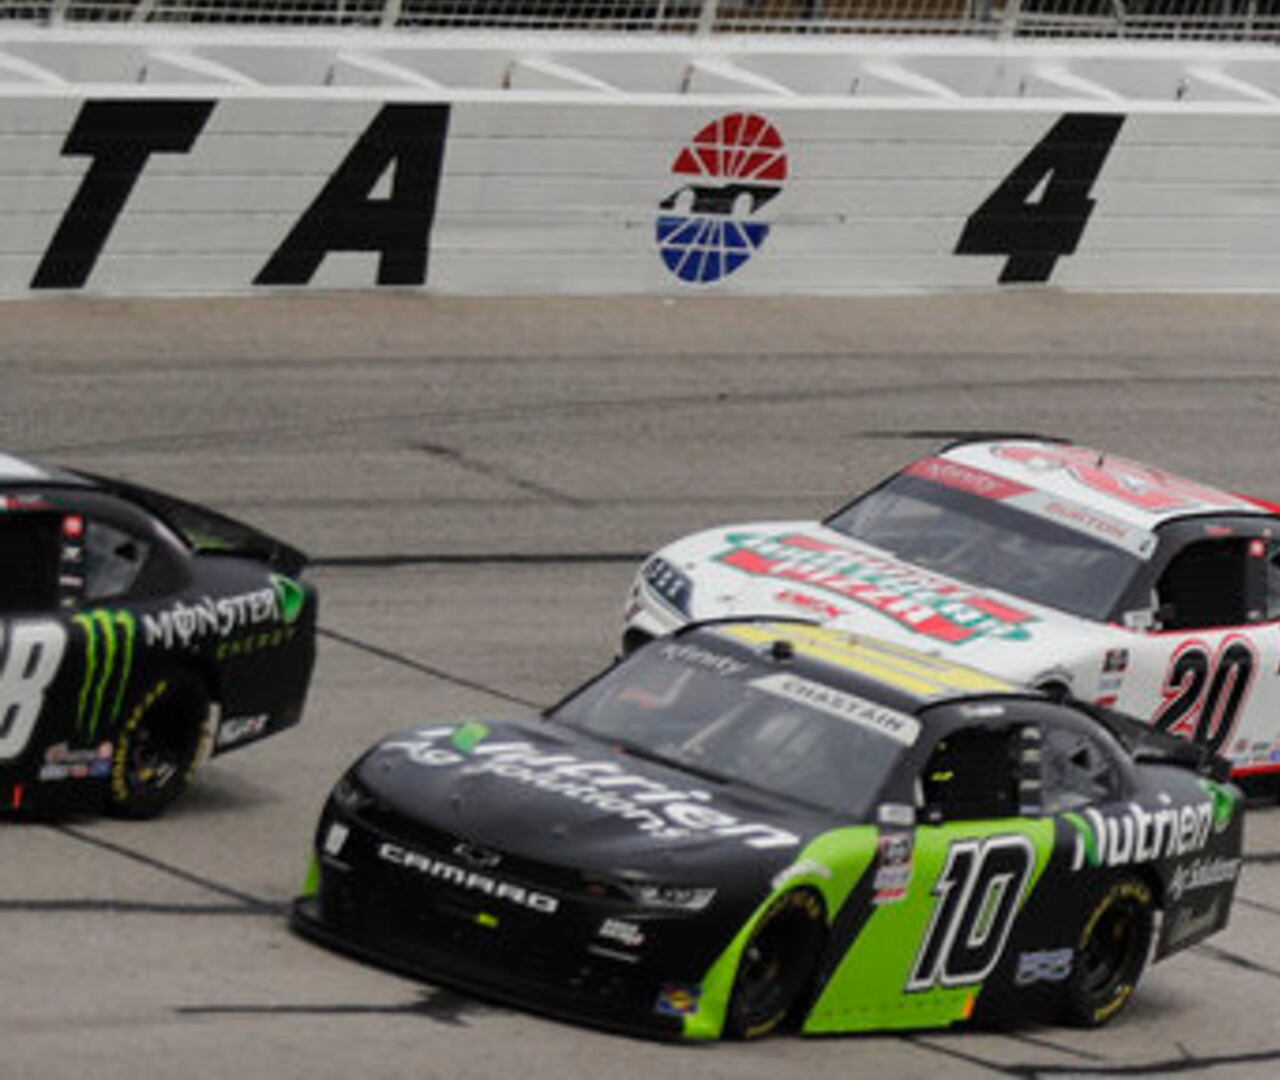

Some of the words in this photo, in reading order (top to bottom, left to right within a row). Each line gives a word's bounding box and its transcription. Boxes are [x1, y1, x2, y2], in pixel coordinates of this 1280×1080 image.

[953, 112, 1127, 285] 4
[782, 680, 905, 733] CHASTAIN
[1148, 632, 1259, 760] 20
[416, 726, 800, 849] Nutrien
[1072, 792, 1213, 871] Nutrien
[379, 840, 561, 915] CAMARO
[905, 834, 1036, 993] 10
